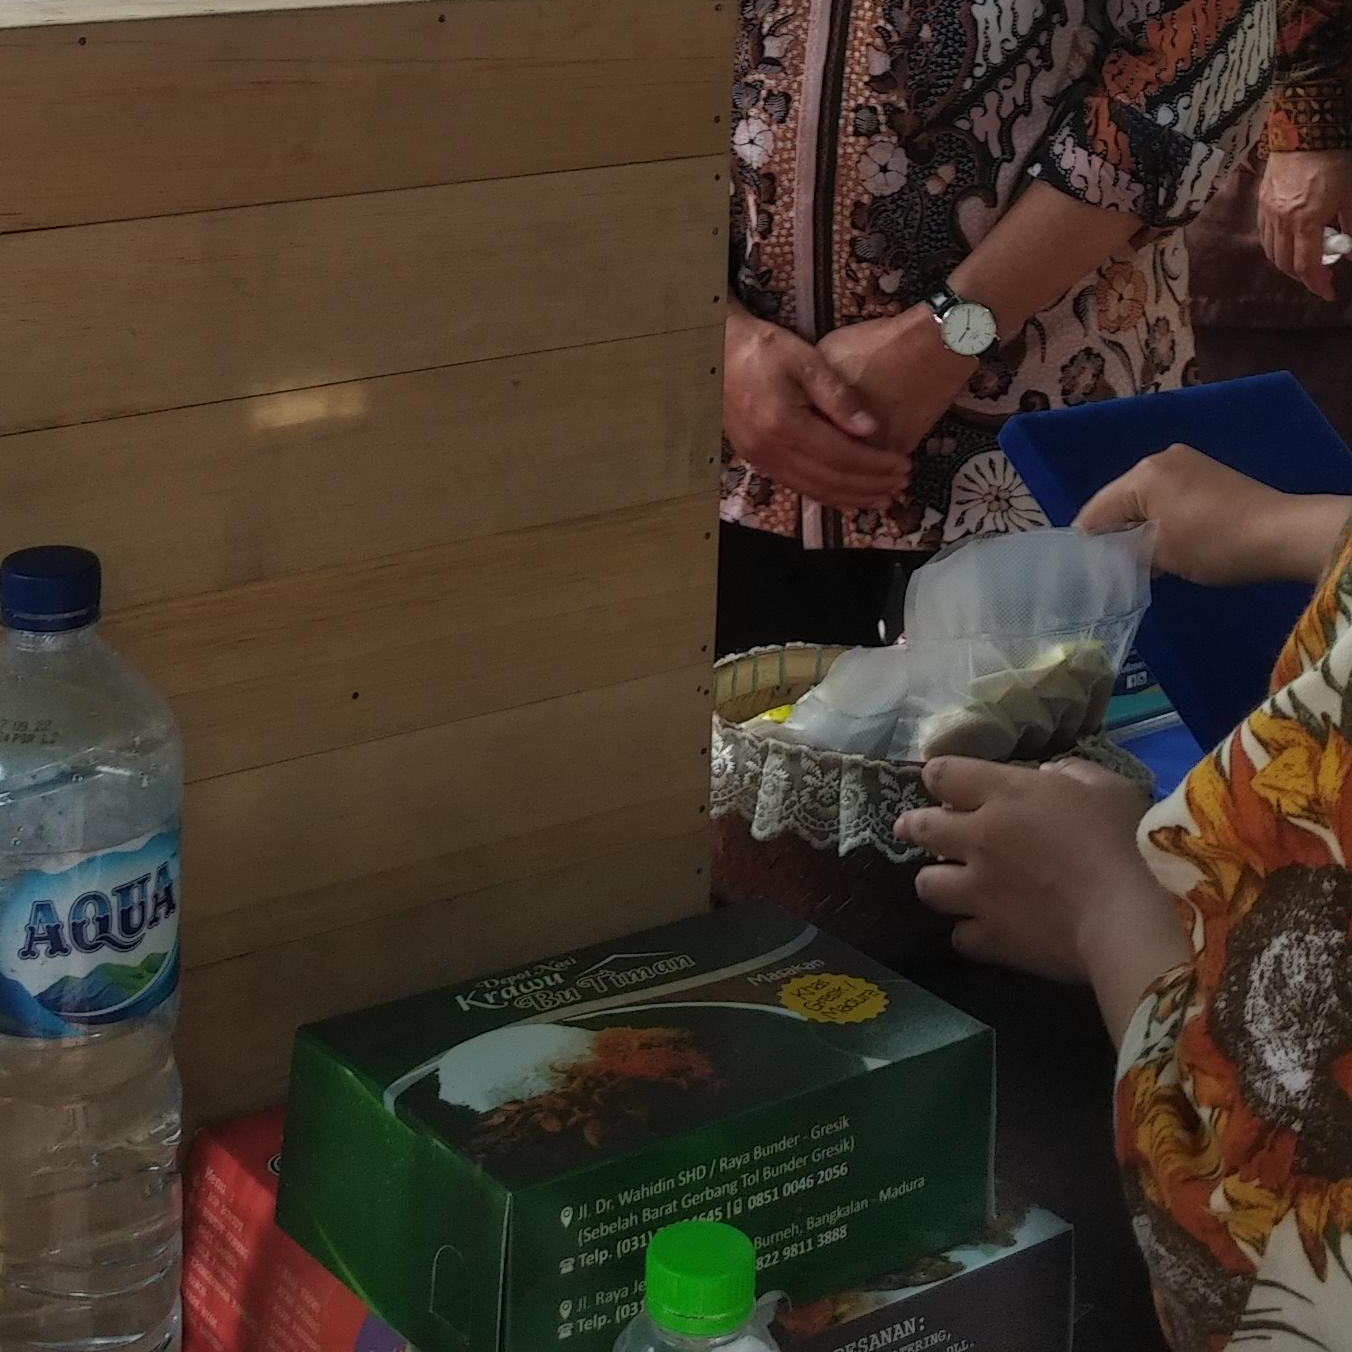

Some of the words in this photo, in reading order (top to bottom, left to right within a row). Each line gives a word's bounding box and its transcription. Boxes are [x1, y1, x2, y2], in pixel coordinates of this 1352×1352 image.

[19, 860, 177, 960] AQUA
[454, 971, 566, 1012] Krawu
[513, 987, 583, 1012] Bu
[747, 959, 825, 986] Masakan
[820, 989, 881, 1020] Madura
[577, 1211, 639, 1247] (Sebelah
[643, 1199, 679, 1224] Barat
[681, 1179, 739, 1213] Gerbang
[742, 1171, 760, 1190] Tol
[763, 1155, 809, 1183] Bunder
[811, 1135, 855, 1164] Gresik)
[595, 1196, 615, 1215] Dr.
[618, 1177, 676, 1207] Wahidin
[678, 1164, 707, 1188] SHD
[719, 1151, 750, 1177] Raya
[753, 1133, 801, 1161] Bunder
[810, 1114, 850, 1140] Gresik
[579, 1247, 613, 1270] Telp.
[748, 1186, 780, 1211] 0851
[782, 1175, 815, 1198] 0046
[817, 1162, 849, 1186] 2056
[595, 1282, 628, 1307] Raya
[806, 1199, 869, 1230] Bangkalan
[878, 1175, 926, 1203] Madura
[577, 1314, 612, 1336] Telp.
[615, 1299, 645, 1327] (031
[783, 1238, 814, 1263] 9811
[817, 1224, 848, 1251] 3888
